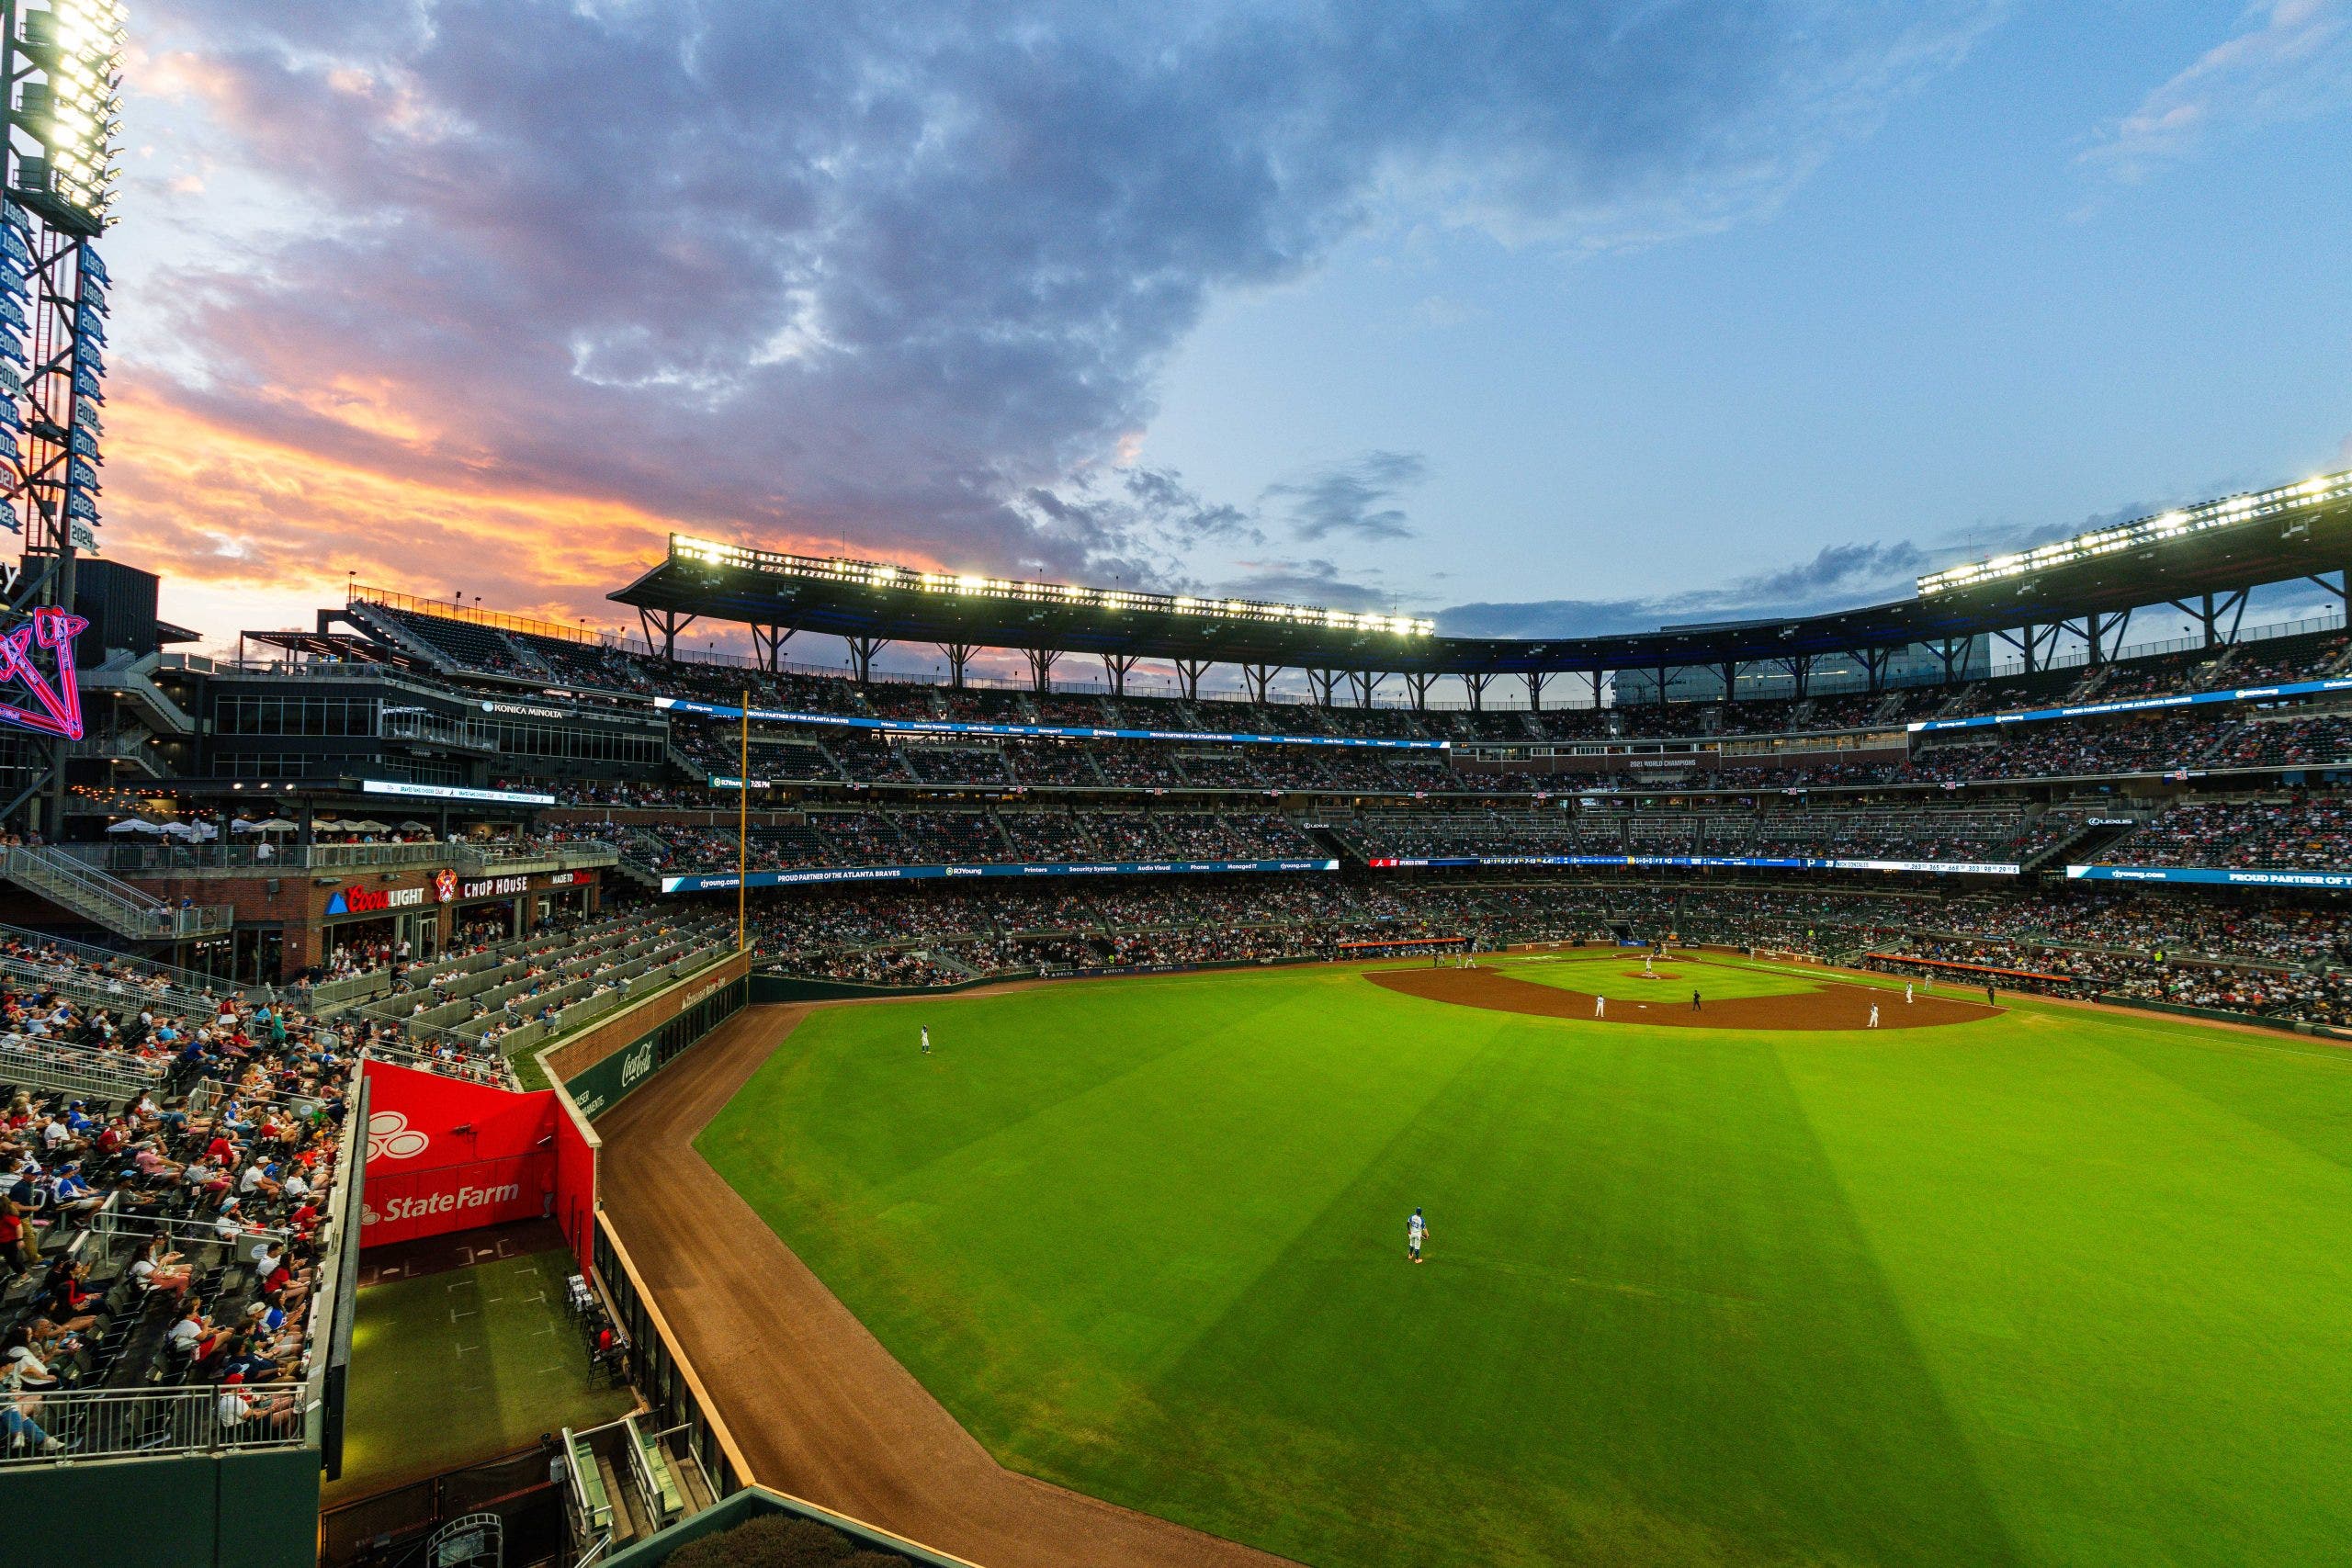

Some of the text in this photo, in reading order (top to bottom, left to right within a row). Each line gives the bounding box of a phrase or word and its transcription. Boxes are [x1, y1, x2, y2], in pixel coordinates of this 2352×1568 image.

[4, 199, 28, 231] 1996
[2, 232, 27, 263] 1998
[85, 252, 105, 278] 1997
[1, 265, 26, 295] 2000
[84, 281, 104, 309] 1999
[0, 299, 24, 327] 2002
[82, 315, 102, 339] 2001
[81, 344, 100, 367] 2003
[79, 372, 99, 398] 2005
[0, 400, 17, 423] 013
[77, 402, 97, 426] 2012
[0, 434, 17, 457] 019
[76, 434, 96, 457] 2018
[0, 467, 15, 490] 021
[75, 463, 95, 488] 2020
[0, 504, 14, 525] 23
[74, 494, 94, 517] 2022
[72, 525, 93, 547] 2024
[494, 705, 562, 718] KONICA MINOLTA
[2134, 699, 2164, 707] ATLANTA
[464, 875, 527, 898] CHOP HOUSE
[552, 874, 567, 884] MADE
[567, 873, 574, 882] TO
[700, 878, 740, 887] rjyoung.com
[2112, 870, 2165, 880] rjyoung.com
[2229, 874, 2268, 882] PROUD
[2270, 875, 2324, 884] PARTNER
[2325, 876, 2343, 885] OF
[345, 884, 424, 912] Coors LIGHT
